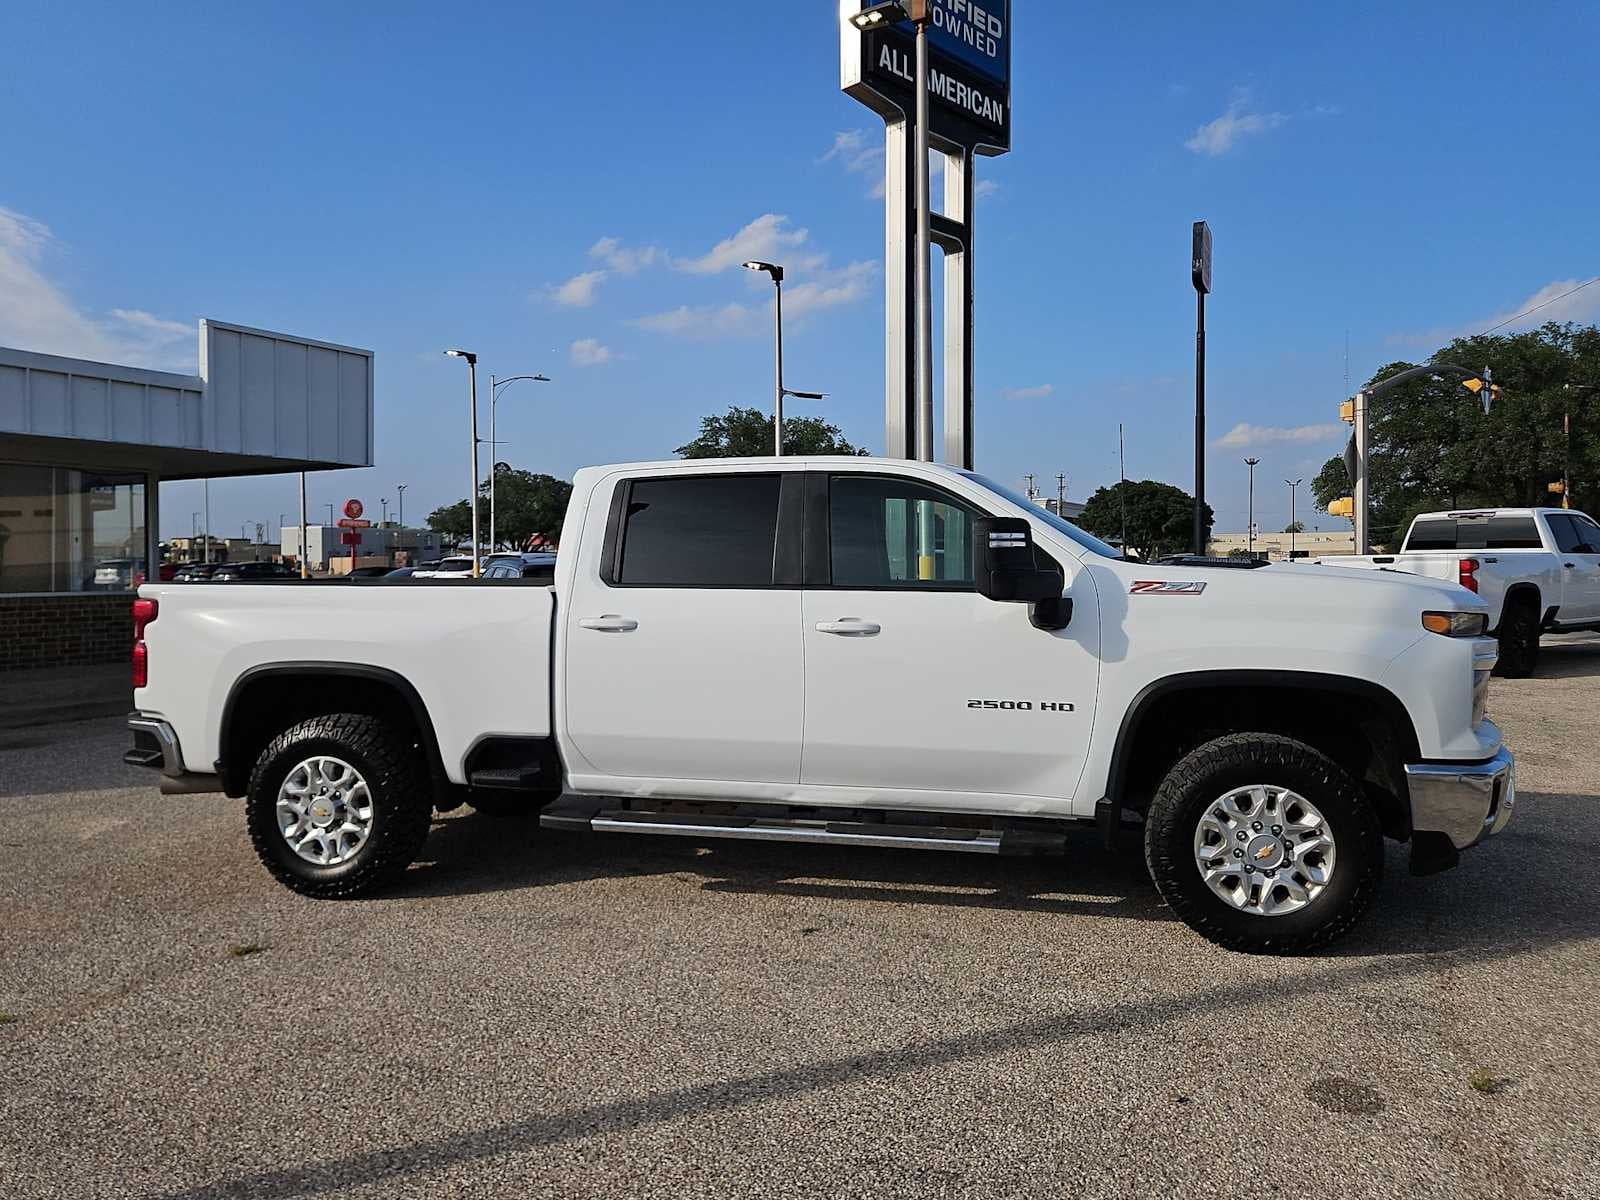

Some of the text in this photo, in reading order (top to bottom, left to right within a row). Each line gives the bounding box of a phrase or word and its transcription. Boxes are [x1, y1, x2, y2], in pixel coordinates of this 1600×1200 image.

[933, 6, 996, 57] OWNED
[879, 44, 1003, 125] ALL MERICAN
[967, 699, 1074, 712] 2500 HD
